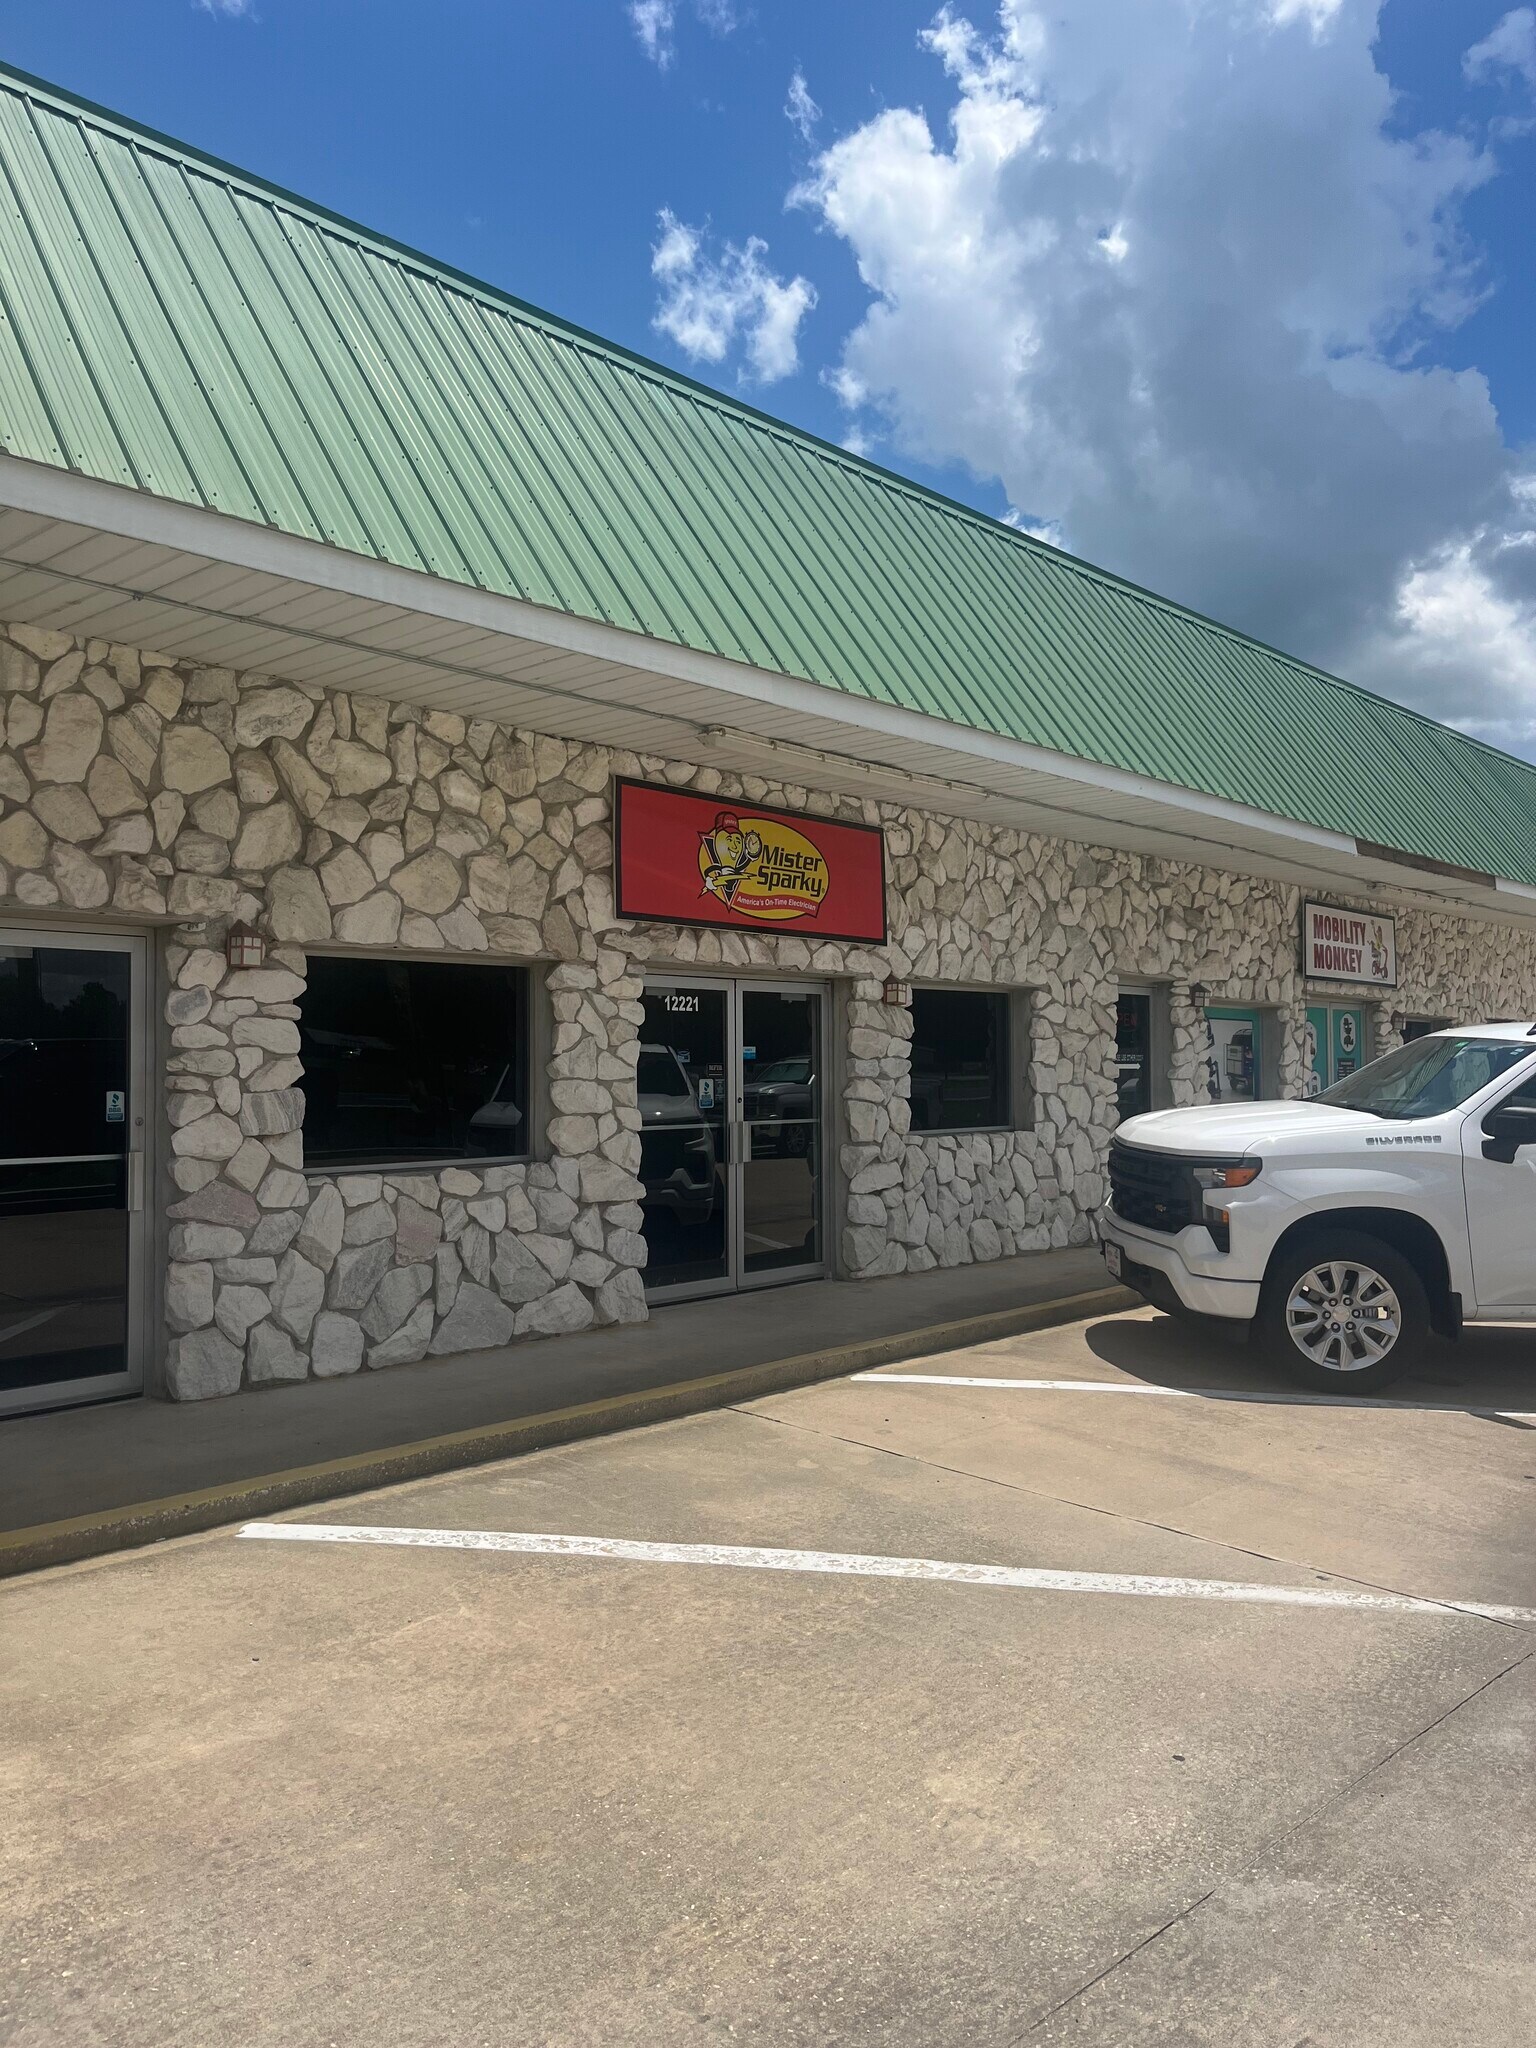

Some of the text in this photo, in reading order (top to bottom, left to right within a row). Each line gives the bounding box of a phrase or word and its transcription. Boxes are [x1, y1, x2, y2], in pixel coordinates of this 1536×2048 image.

[761, 845, 822, 872] Mister
[757, 865, 822, 897] Sparky
[737, 896, 816, 911] America's On-Time Electrician
[1313, 914, 1366, 946] MOBILITY
[1314, 943, 1363, 974] MONKEY
[665, 995, 699, 1012] 12221
[1117, 1012, 1138, 1027] PEN
[1365, 1135, 1442, 1146] SILVERADO
